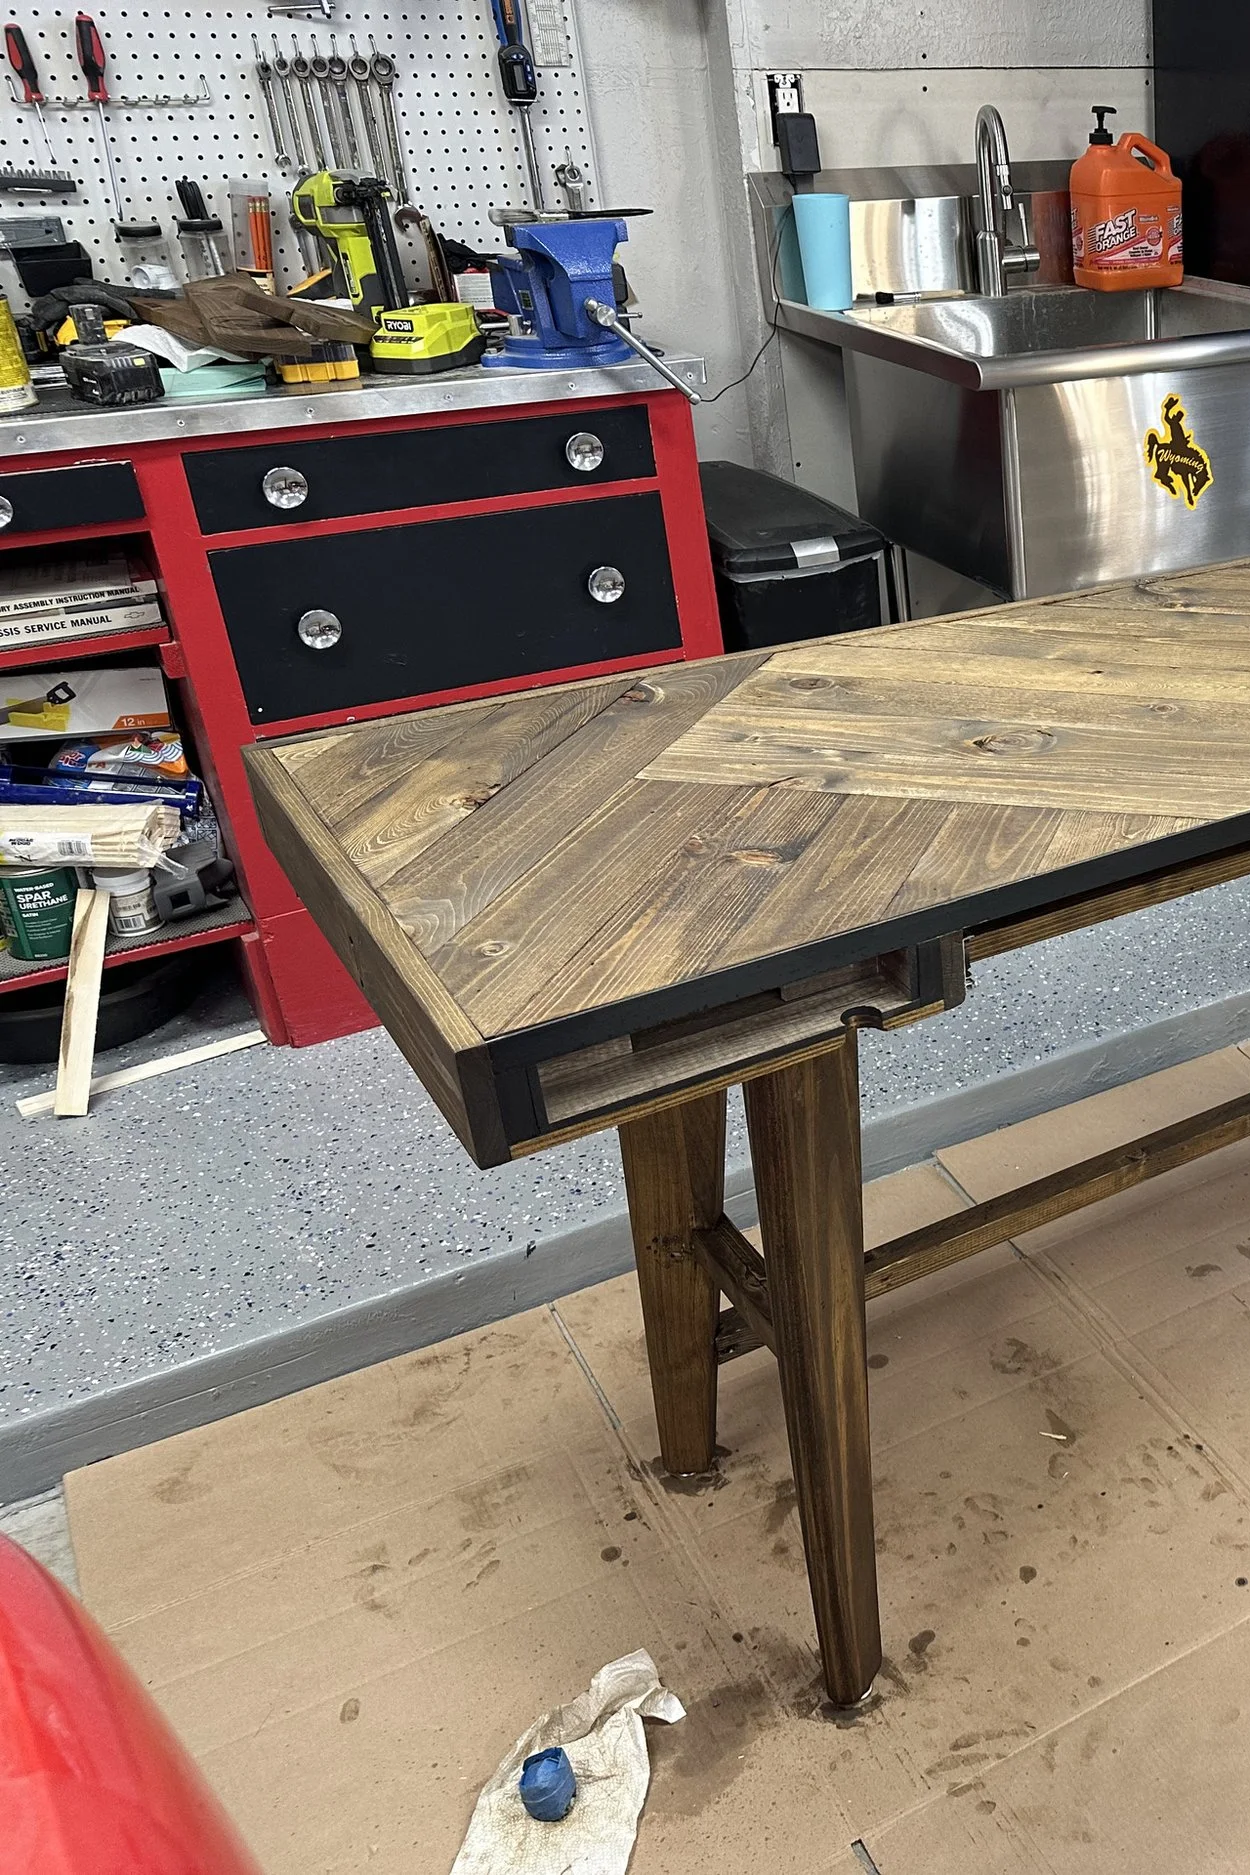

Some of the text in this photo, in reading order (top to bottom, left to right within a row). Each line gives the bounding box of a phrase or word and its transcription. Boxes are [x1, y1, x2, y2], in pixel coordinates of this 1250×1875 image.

[1094, 208, 1137, 242] FAST
[1095, 226, 1137, 252] ORANGE
[386, 320, 412, 331] RYOBI
[1157, 449, 1204, 474] Wyoming
[13, 598, 53, 611] ASSEMBLY
[55, 591, 106, 604] INSTRUCTION
[107, 586, 140, 597] MANUAL
[24, 621, 67, 634] SERVICE
[71, 615, 112, 627] MANUAL
[121, 717, 146, 727] 12 in
[13, 882, 55, 893] WATER-BASED
[16, 890, 52, 903] SPAR
[18, 894, 69, 910] URETHANE
